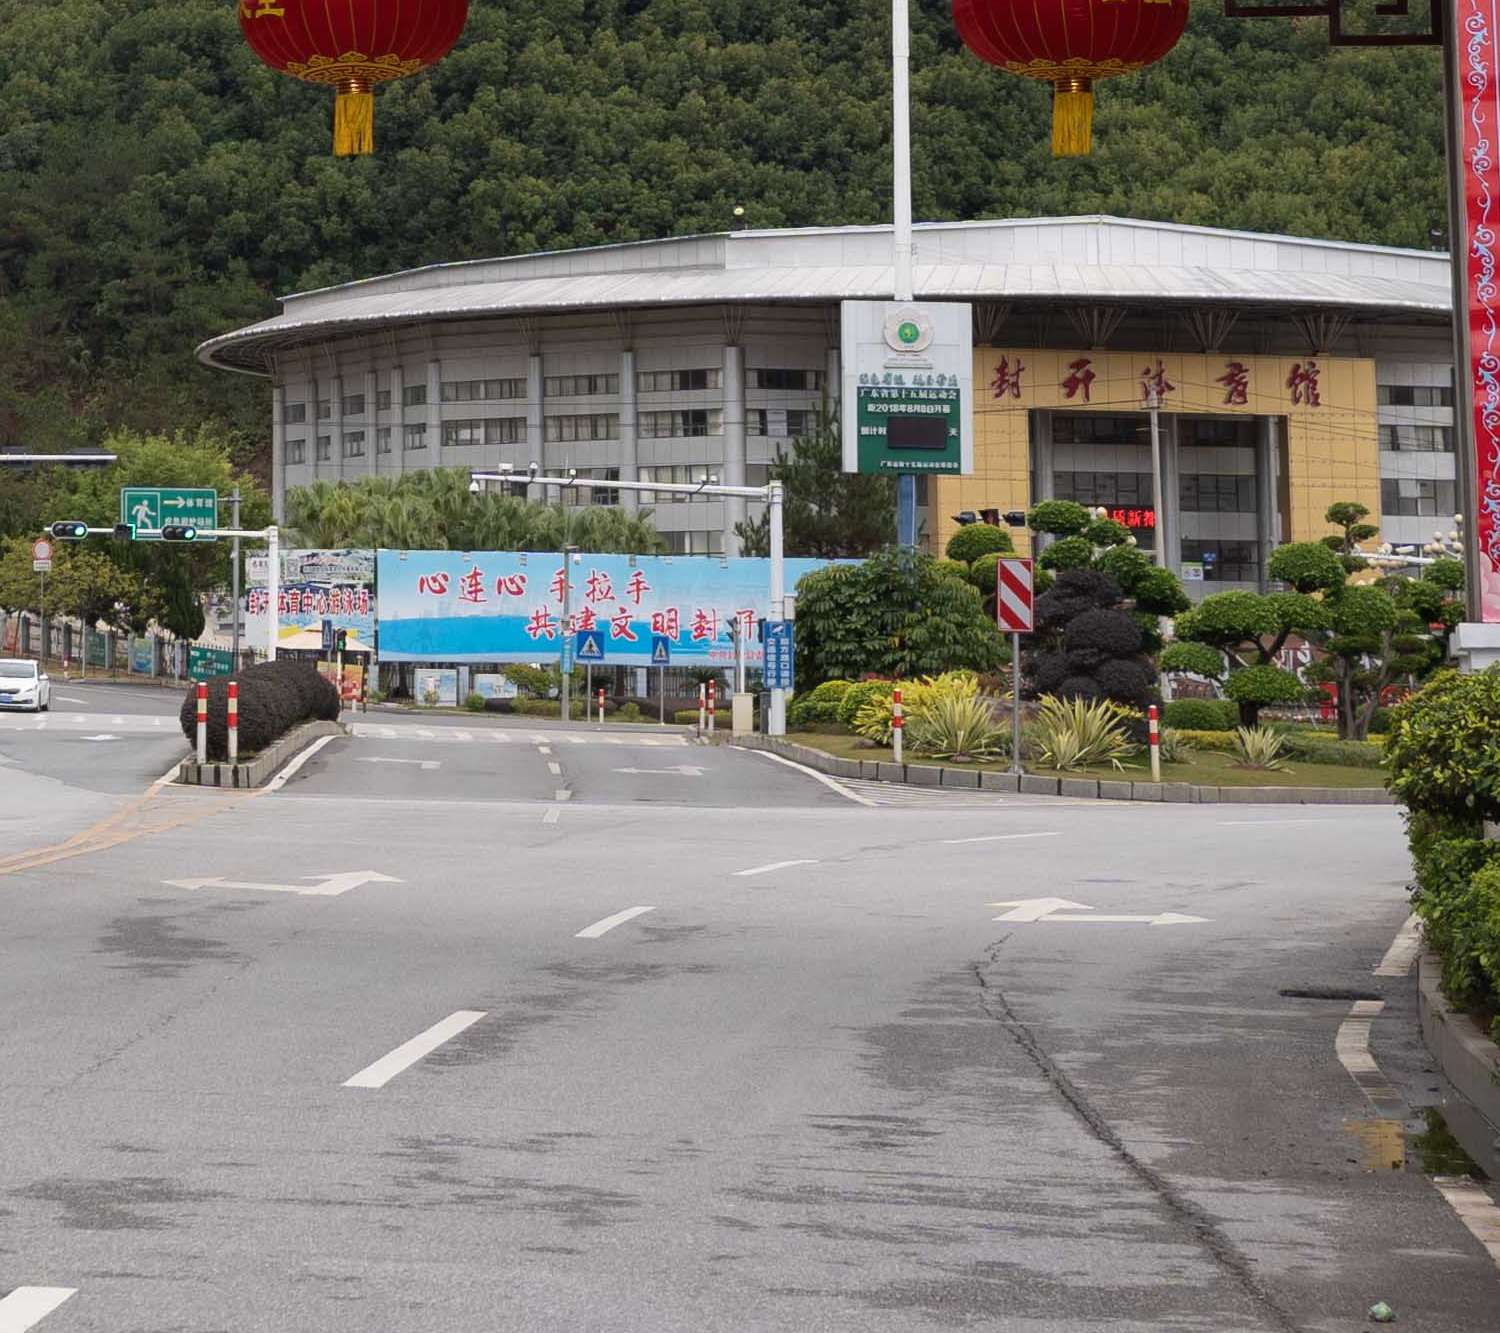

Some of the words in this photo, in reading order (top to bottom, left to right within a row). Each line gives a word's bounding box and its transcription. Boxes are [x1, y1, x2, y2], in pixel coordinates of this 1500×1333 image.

[990, 354, 1322, 408] 封开体育馆
[949, 428, 958, 437] 天
[418, 565, 527, 605] 心连心
[549, 568, 653, 606] 手拉手
[526, 605, 761, 642] 共建文明封开
